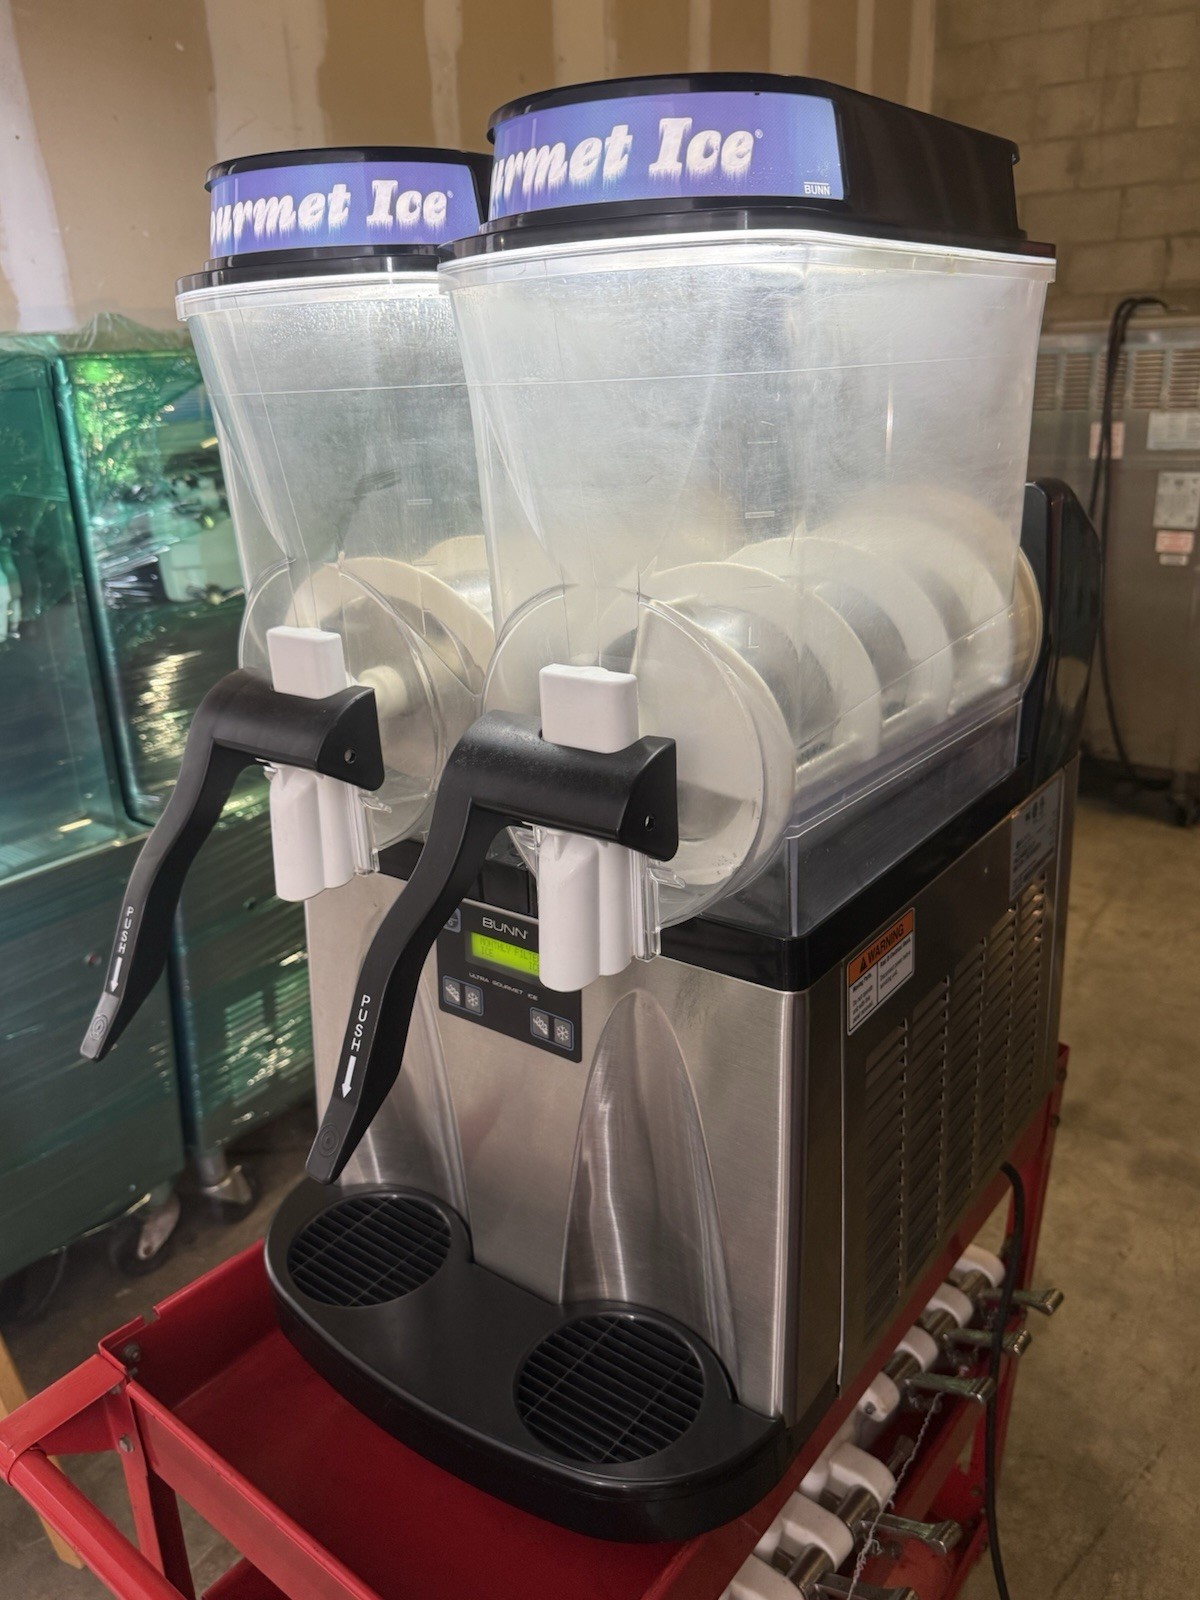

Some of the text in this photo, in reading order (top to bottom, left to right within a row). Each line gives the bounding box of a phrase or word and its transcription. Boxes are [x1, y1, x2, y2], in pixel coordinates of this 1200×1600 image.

[803, 182, 831, 196] BUNN
[118, 905, 135, 955] PUSH
[483, 917, 527, 939] BUNN
[514, 947, 539, 962] FILTE
[868, 923, 904, 963] WARNING
[469, 972, 538, 1001] ULTRA GOURMET ICE
[350, 994, 371, 1052] PUSH
